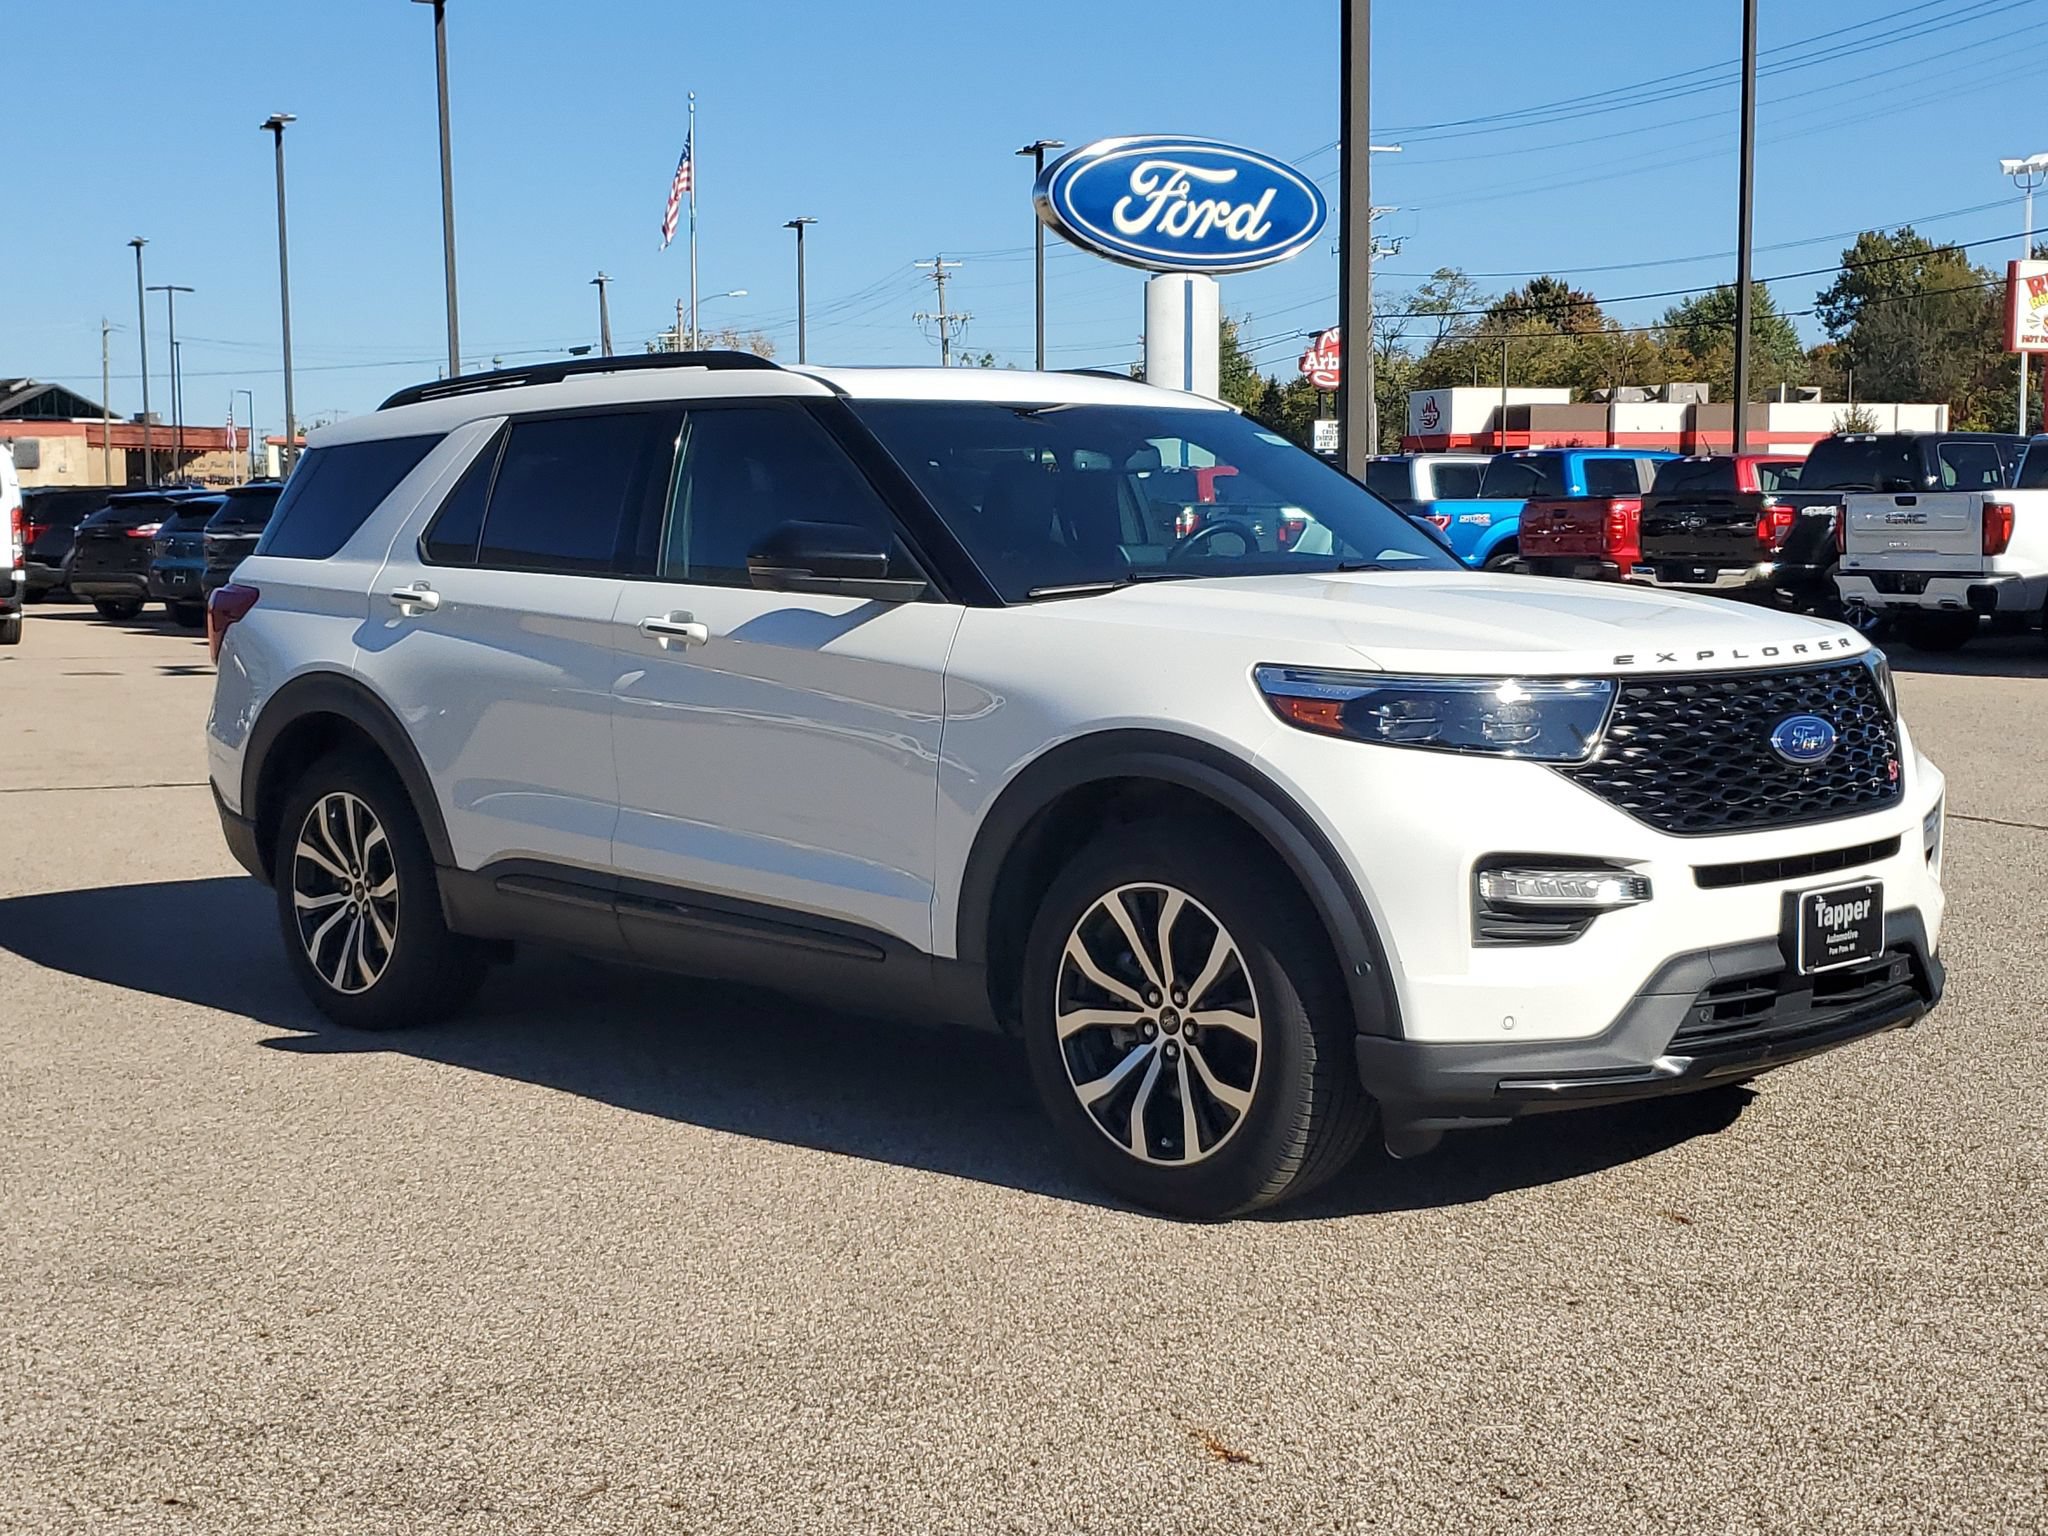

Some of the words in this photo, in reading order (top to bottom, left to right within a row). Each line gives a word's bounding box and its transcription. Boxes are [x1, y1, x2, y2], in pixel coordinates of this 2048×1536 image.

[1113, 160, 1278, 242] Ford
[2026, 274, 2048, 298] R
[1303, 351, 1340, 371] Arb
[1885, 512, 1928, 525] GMC
[1612, 637, 1851, 666] EXPLORER
[1791, 725, 1826, 749] Ford
[1815, 899, 1871, 931] Tapper
